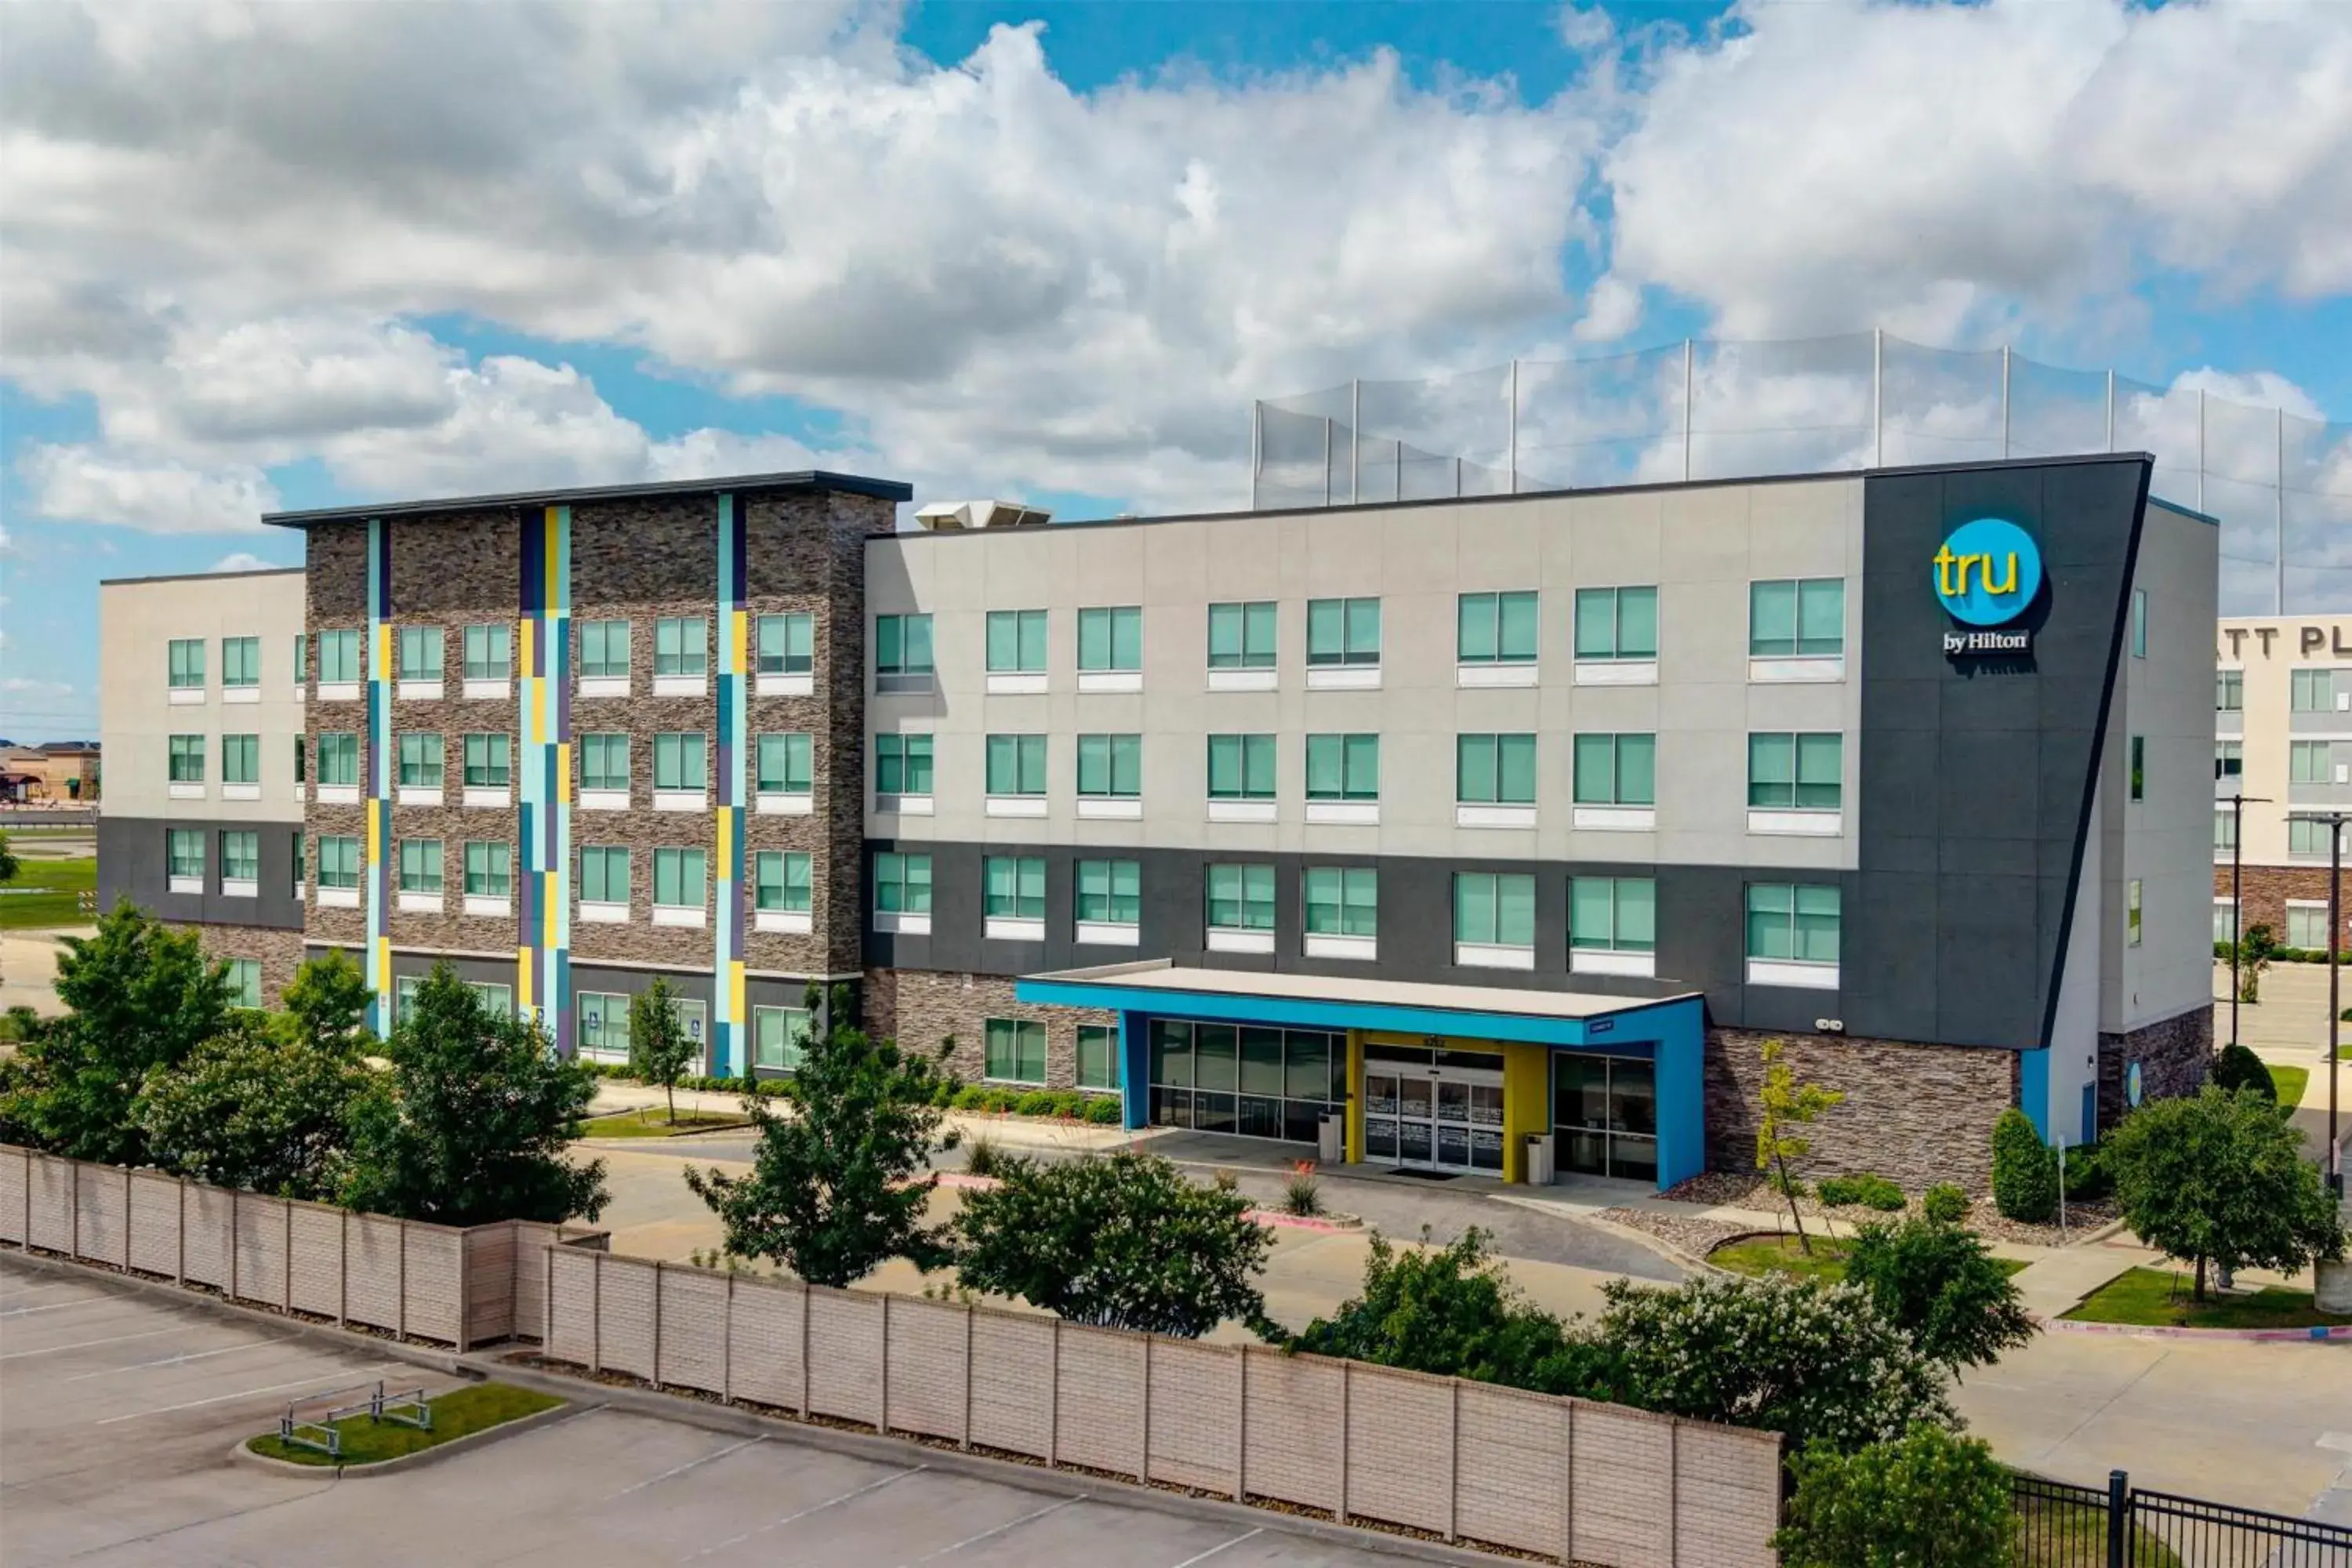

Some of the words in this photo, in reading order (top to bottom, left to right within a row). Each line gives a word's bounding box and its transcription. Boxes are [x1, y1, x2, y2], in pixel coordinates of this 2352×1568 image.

[1933, 543, 2017, 596] tru
[1943, 633, 1966, 654] by
[1969, 633, 2027, 650] Hilton
[2216, 627, 2278, 658] TT
